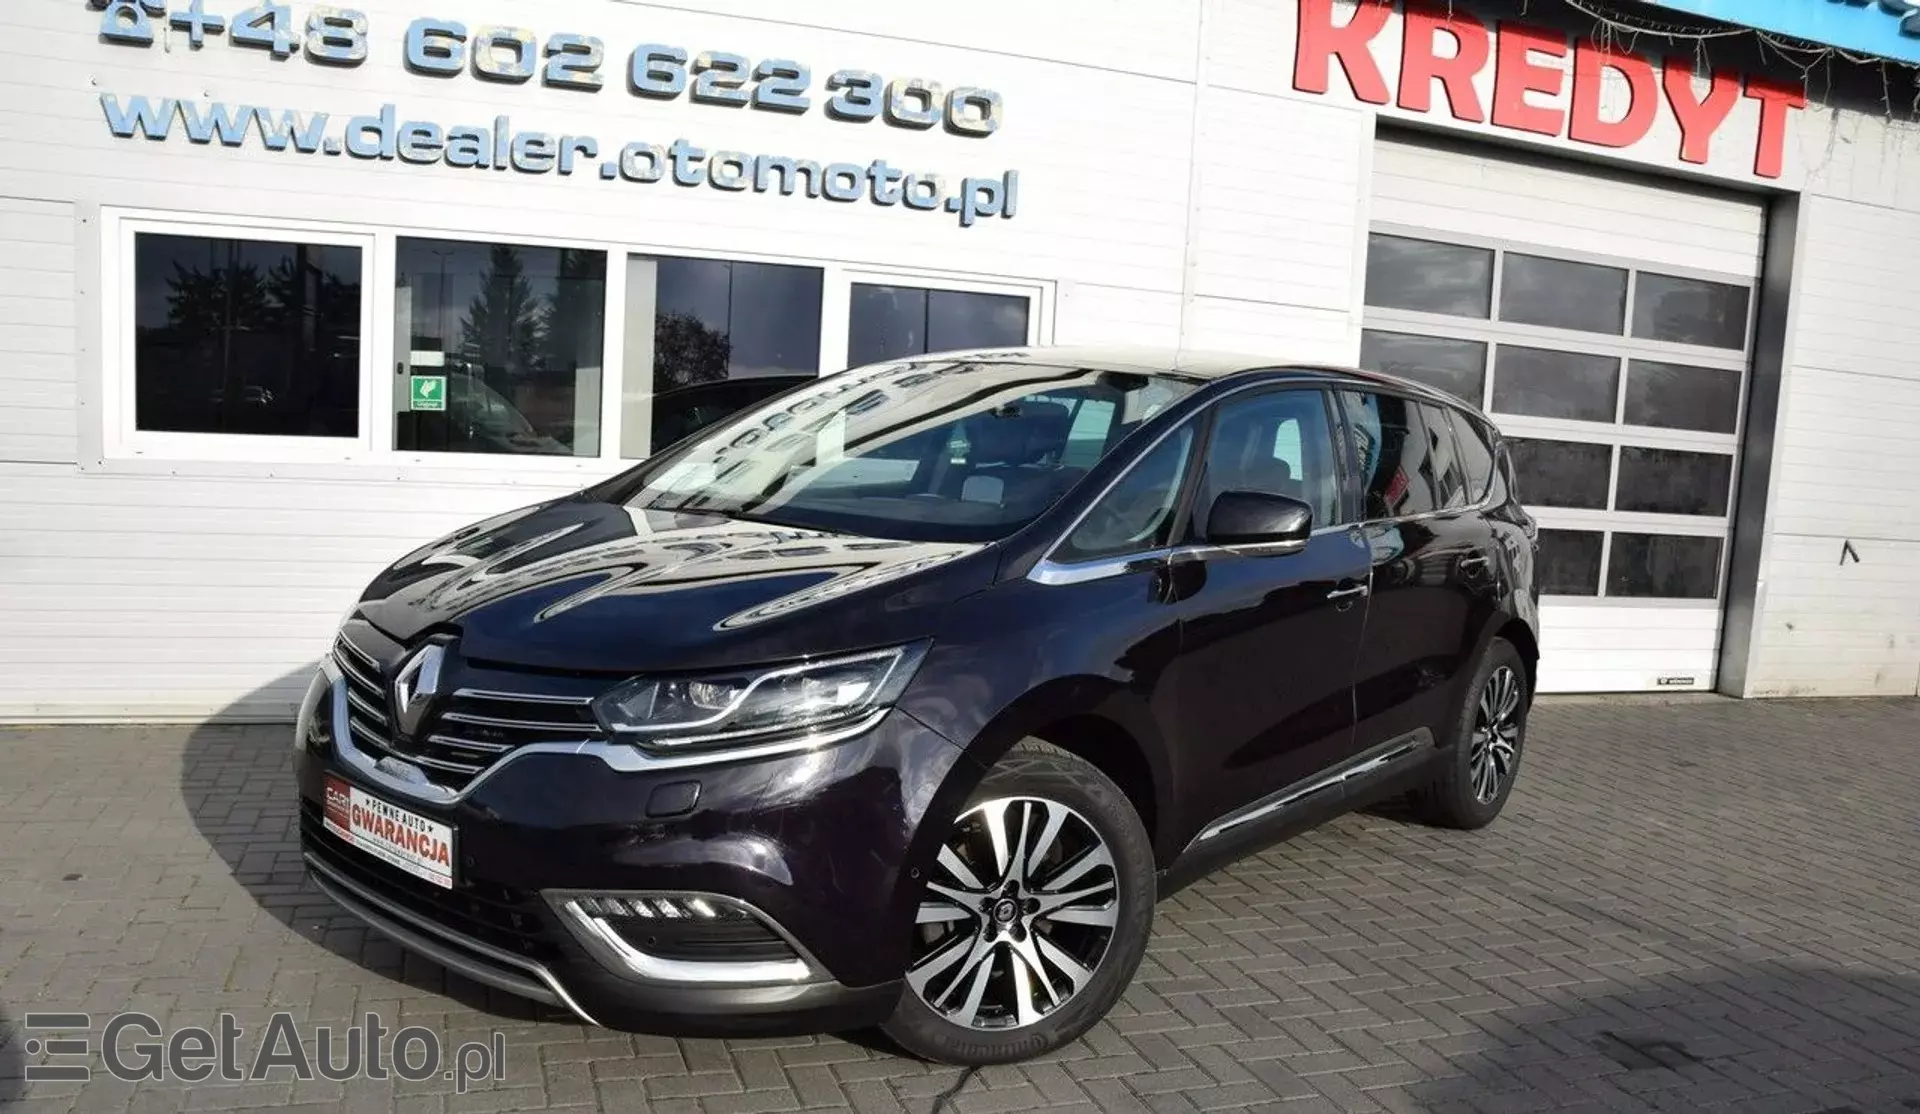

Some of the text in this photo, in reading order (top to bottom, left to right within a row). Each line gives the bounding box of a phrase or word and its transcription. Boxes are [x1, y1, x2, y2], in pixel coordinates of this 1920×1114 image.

[404, 17, 604, 89] 602
[628, 43, 811, 114] 622
[825, 69, 1004, 137] 300
[1292, 0, 1807, 179] KREDYT
[99, 92, 1020, 227] www.dealer.otomoto.pl
[351, 803, 451, 868] GWARANCJA
[371, 799, 400, 822] PEWNE
[402, 814, 427, 833] AUTO
